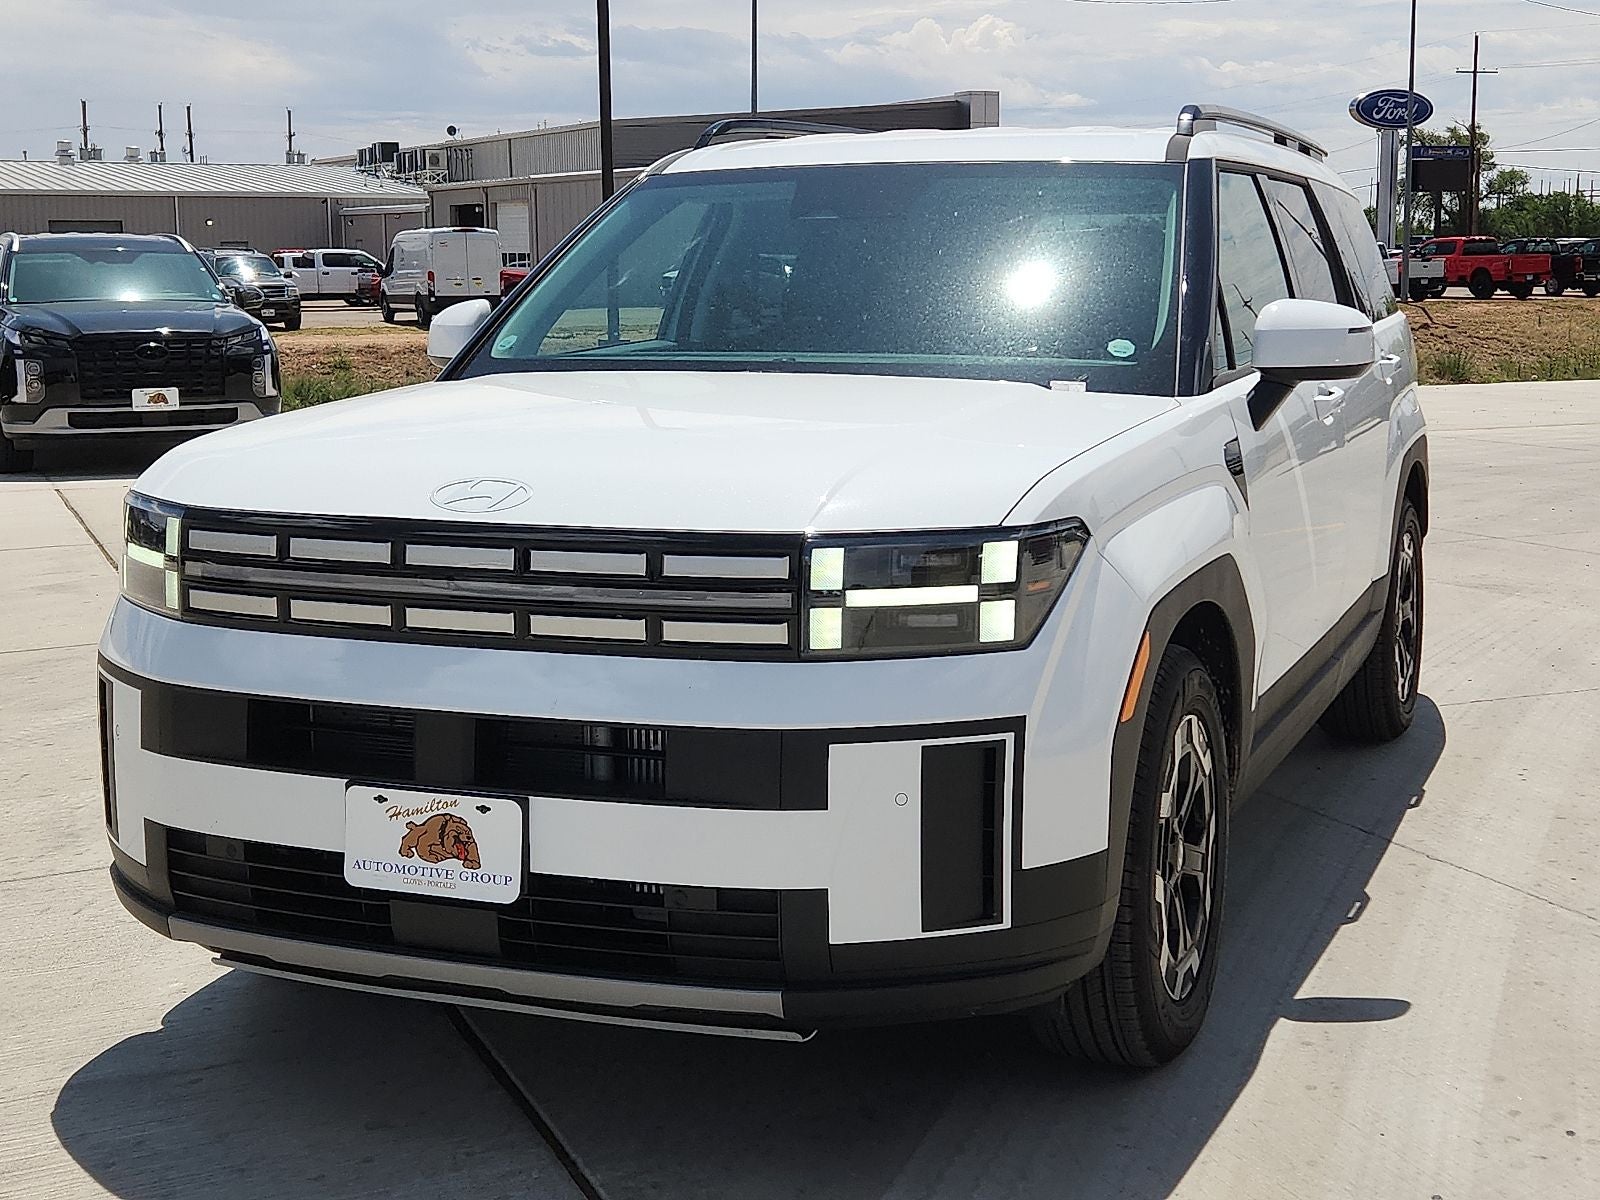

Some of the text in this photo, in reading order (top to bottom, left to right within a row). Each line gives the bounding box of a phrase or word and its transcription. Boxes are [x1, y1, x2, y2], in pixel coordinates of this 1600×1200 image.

[385, 798, 460, 821] Hamilton
[352, 859, 513, 886] AUTOMOTIVE GROUP
[402, 878, 457, 889] CLOVIS PORTALES
